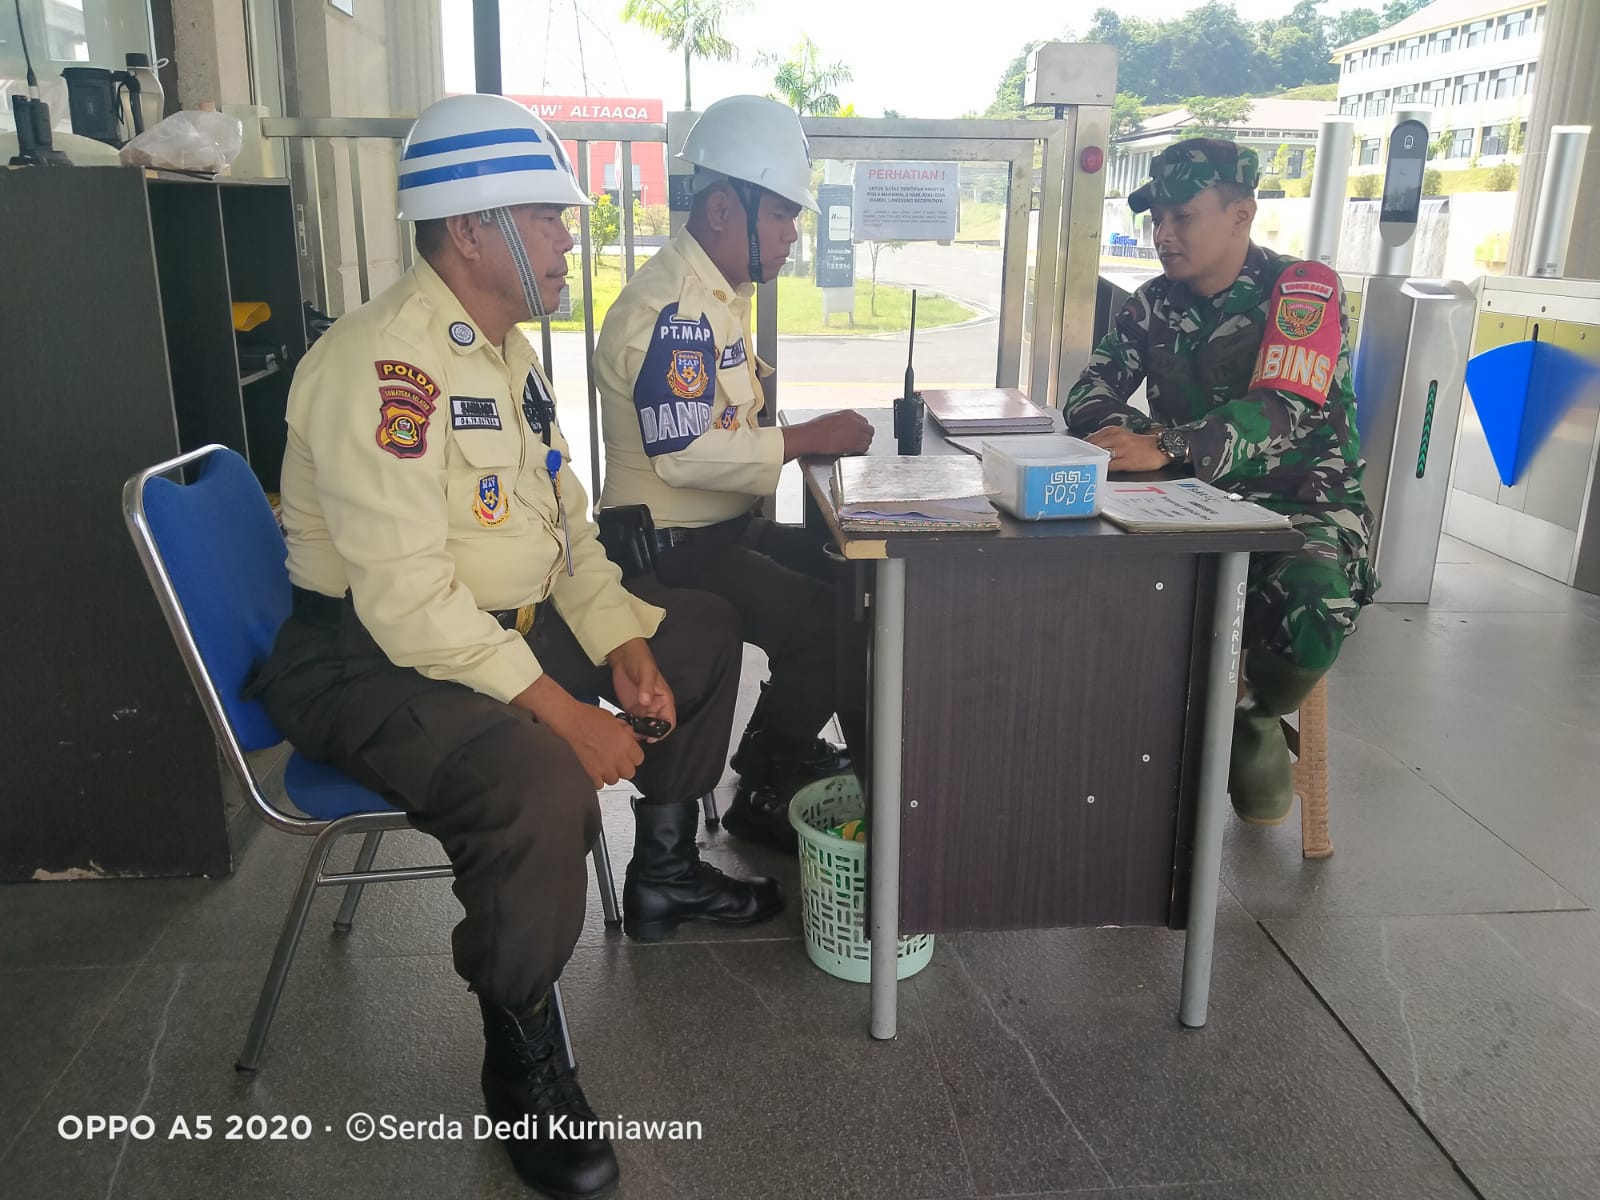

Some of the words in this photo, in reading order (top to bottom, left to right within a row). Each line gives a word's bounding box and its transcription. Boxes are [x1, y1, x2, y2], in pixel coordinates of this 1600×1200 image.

[570, 106, 648, 119] ALTAAQA
[868, 168, 938, 181] PERHATIAN
[661, 325, 711, 342] PT.MAP
[678, 358, 699, 366] MAP
[383, 364, 434, 396] POLDA
[1045, 484, 1079, 506] POS
